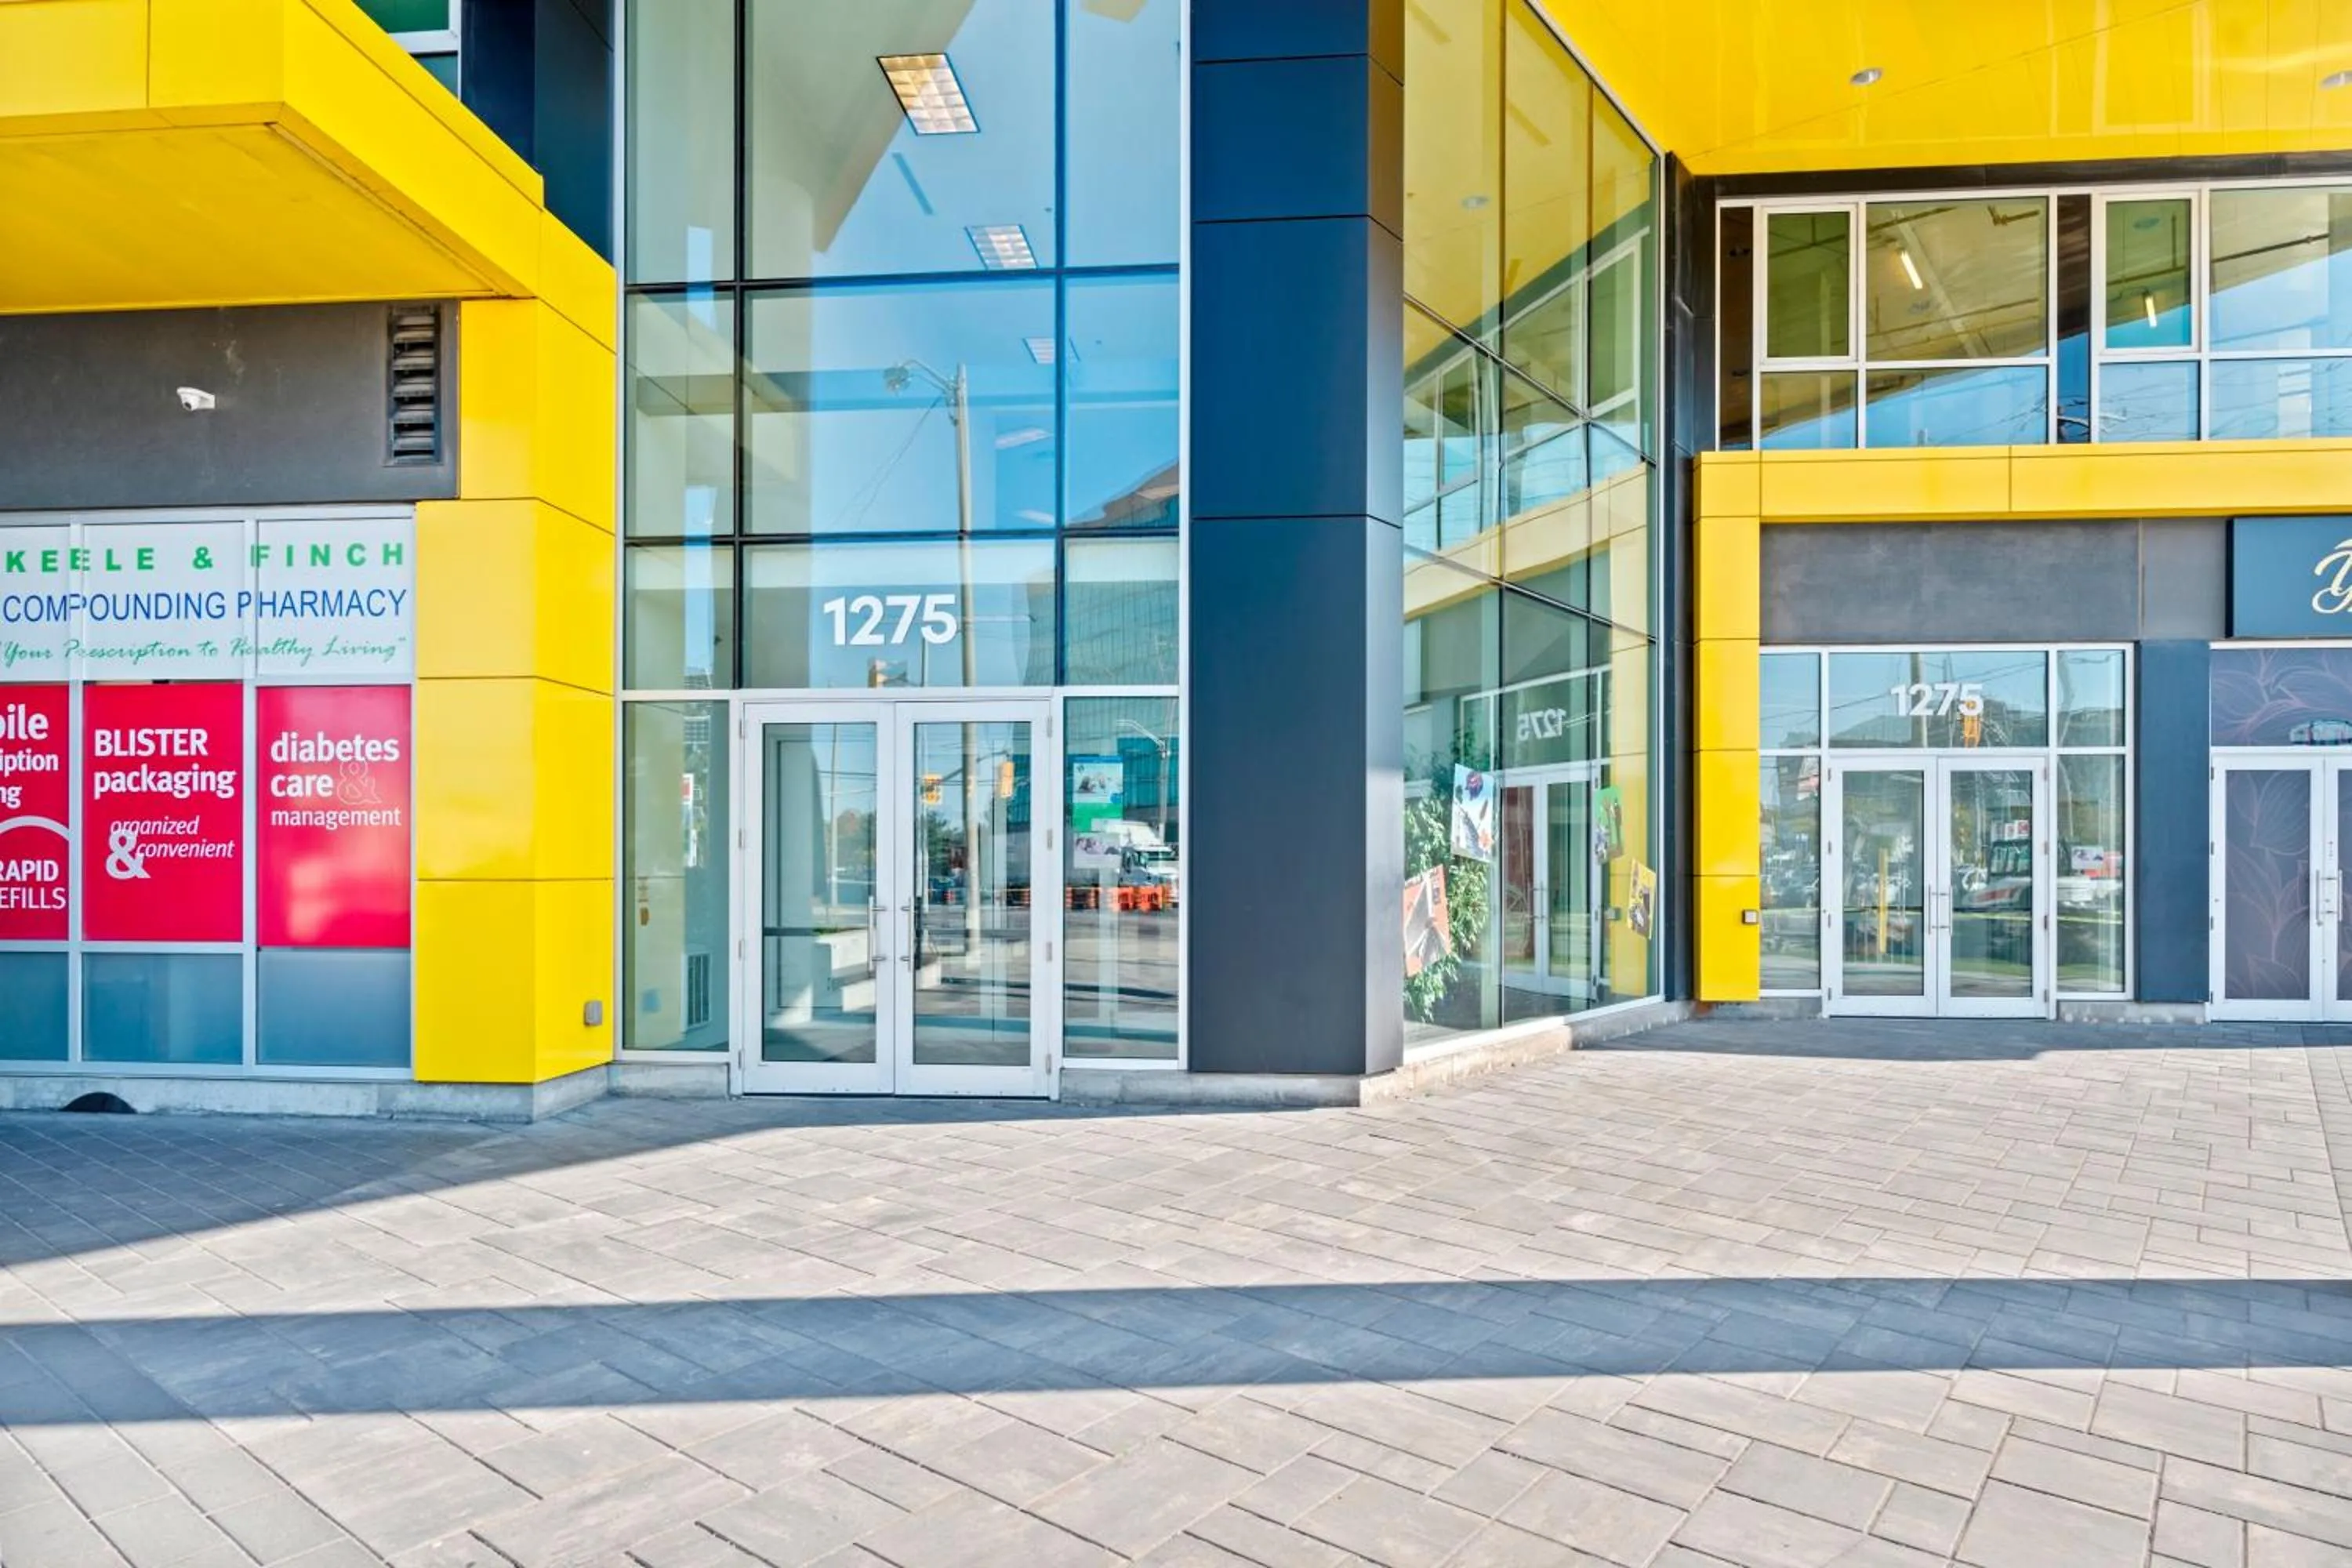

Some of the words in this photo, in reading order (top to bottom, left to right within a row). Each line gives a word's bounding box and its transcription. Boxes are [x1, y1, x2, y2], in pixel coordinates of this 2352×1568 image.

[6, 548, 154, 573] KEELE
[192, 546, 214, 569] &
[250, 543, 404, 568] FINCH
[3, 593, 225, 622] COMPOUNDING
[238, 590, 407, 617] PHARMACY
[824, 594, 957, 645] 1275
[198, 640, 219, 656] to
[1890, 683, 1984, 716] 1275
[94, 728, 208, 756] BLISTER
[270, 731, 400, 762] diabetes
[94, 764, 236, 798] packaging
[270, 773, 333, 797] care
[111, 815, 200, 839] organized
[270, 807, 401, 830] management
[106, 829, 151, 880] &
[136, 839, 235, 858] convenient
